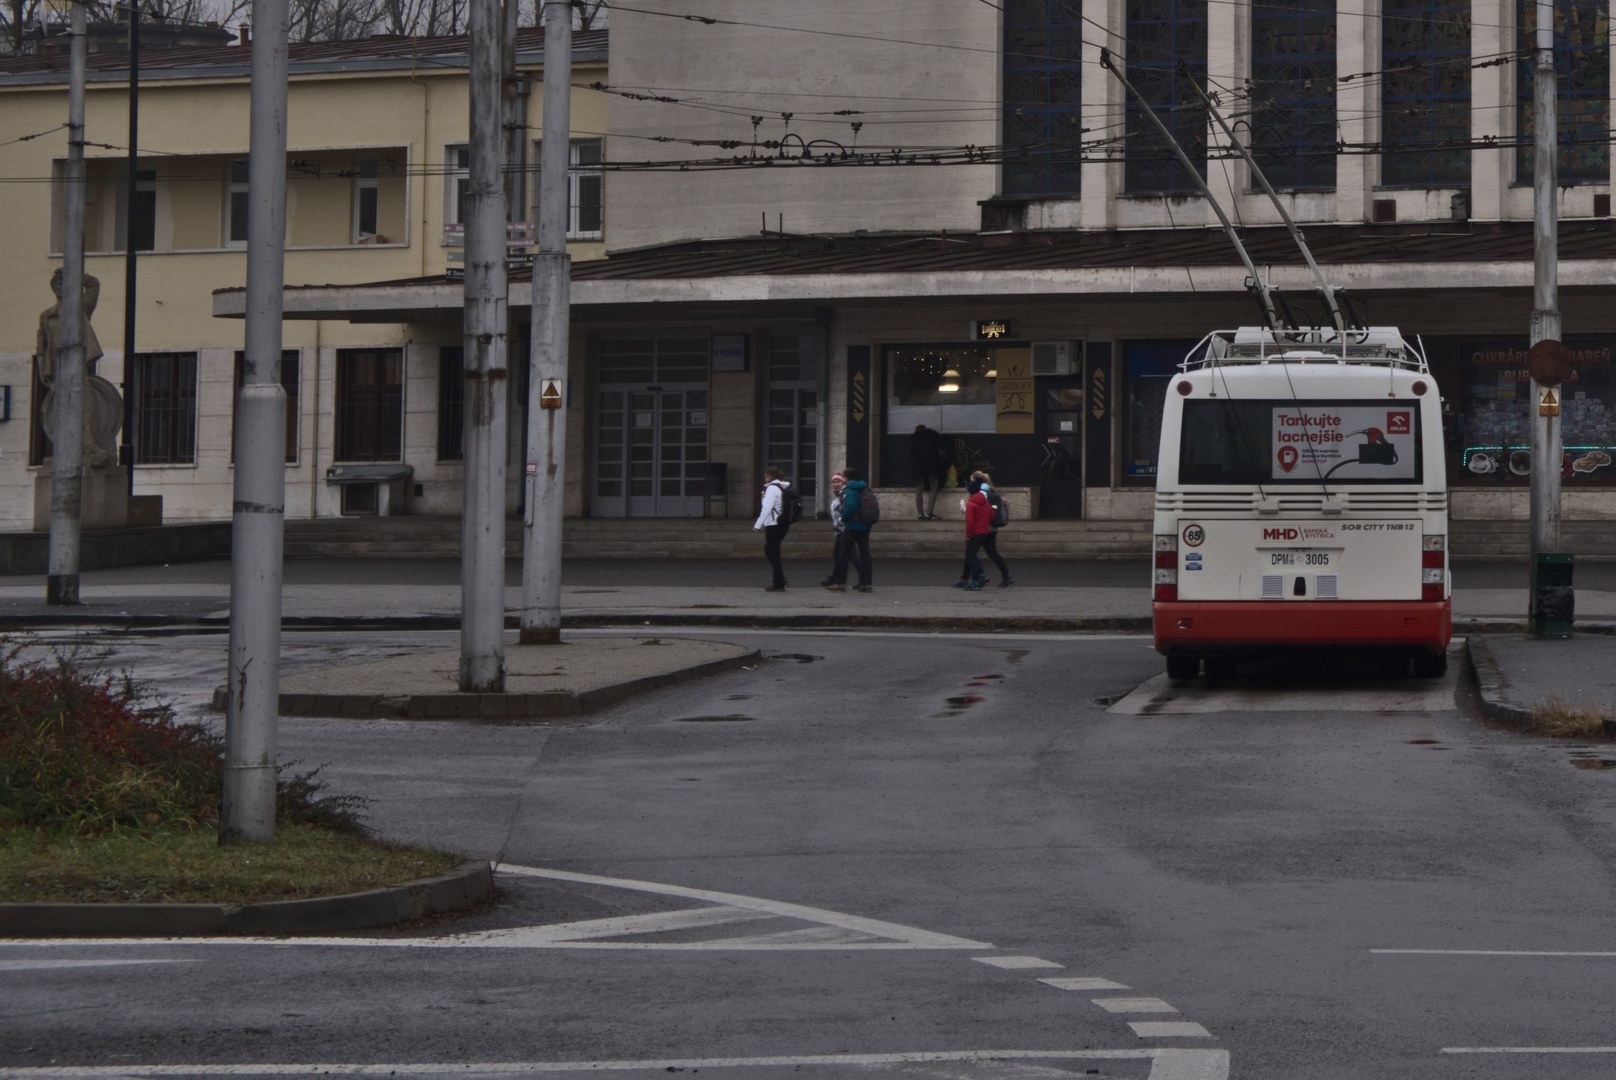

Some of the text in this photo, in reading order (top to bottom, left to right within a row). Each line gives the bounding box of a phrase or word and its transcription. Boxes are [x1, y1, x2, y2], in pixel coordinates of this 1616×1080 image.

[1472, 348, 1530, 364] CUKRÁRE
[1278, 414, 1341, 428] Tankujte
[1278, 430, 1344, 444] lacnejšie
[1188, 531, 1201, 541] 65
[1263, 528, 1298, 540] MHD
[1271, 554, 1329, 565] DPM 3005
